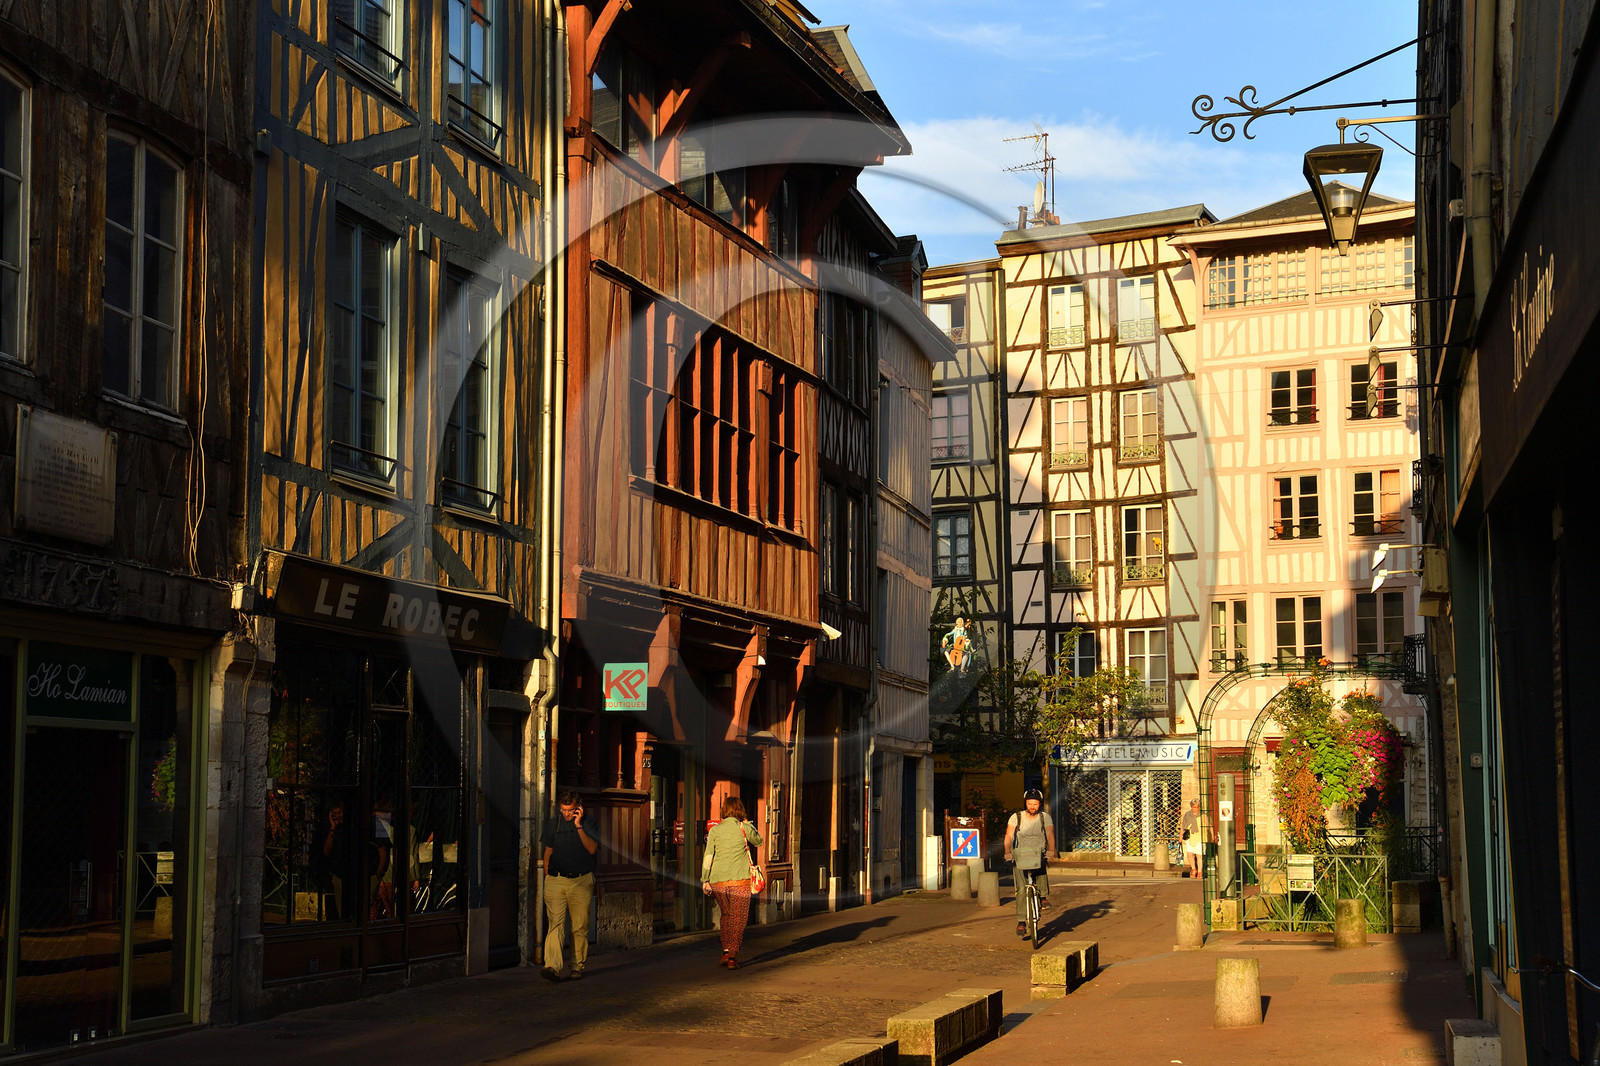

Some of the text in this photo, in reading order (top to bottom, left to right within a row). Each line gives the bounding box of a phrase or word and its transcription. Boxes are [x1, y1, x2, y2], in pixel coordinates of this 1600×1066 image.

[313, 577, 480, 641] LE ROBEC
[27, 662, 129, 706] Ho Lamian
[604, 669, 647, 701] KP
[603, 701, 646, 709] BOUTIQUES
